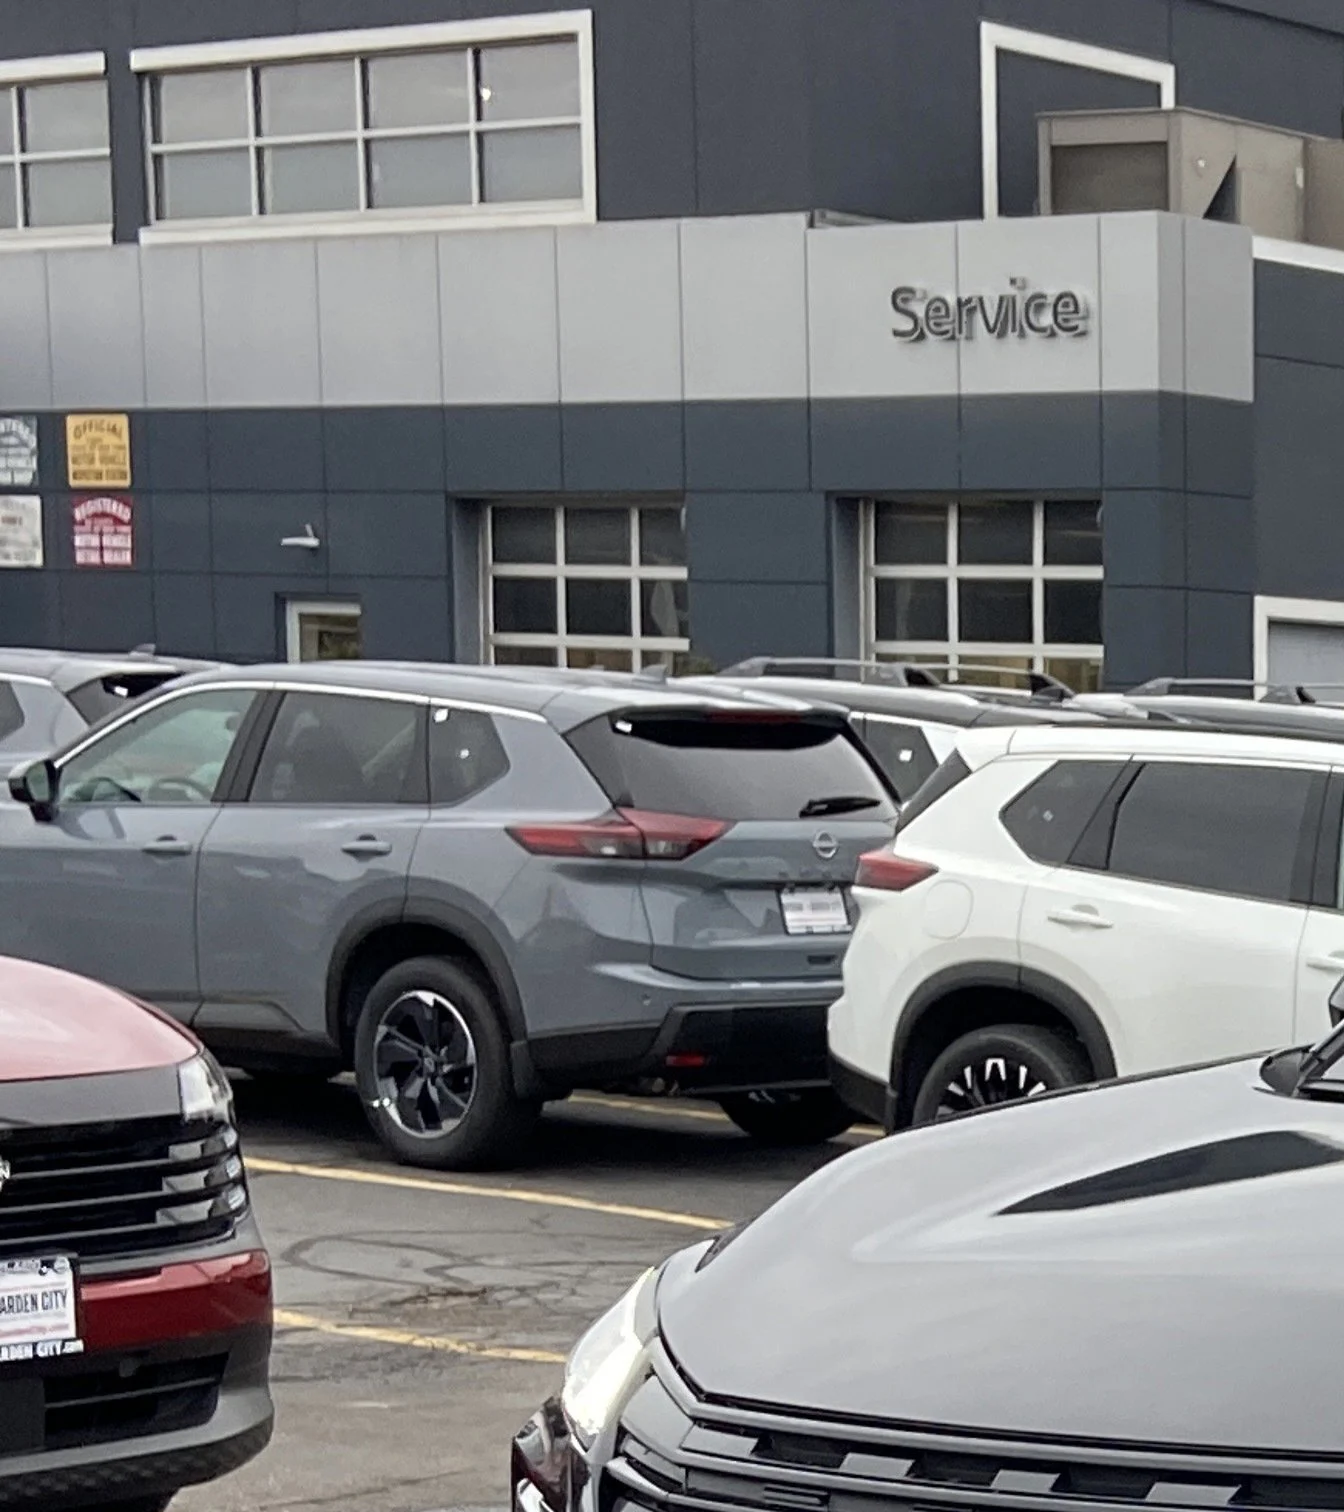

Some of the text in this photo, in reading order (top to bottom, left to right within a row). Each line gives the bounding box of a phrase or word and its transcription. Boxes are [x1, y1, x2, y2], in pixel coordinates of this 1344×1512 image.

[890, 276, 1085, 338] Service
[0, 1289, 68, 1314] ARDEN CITY
